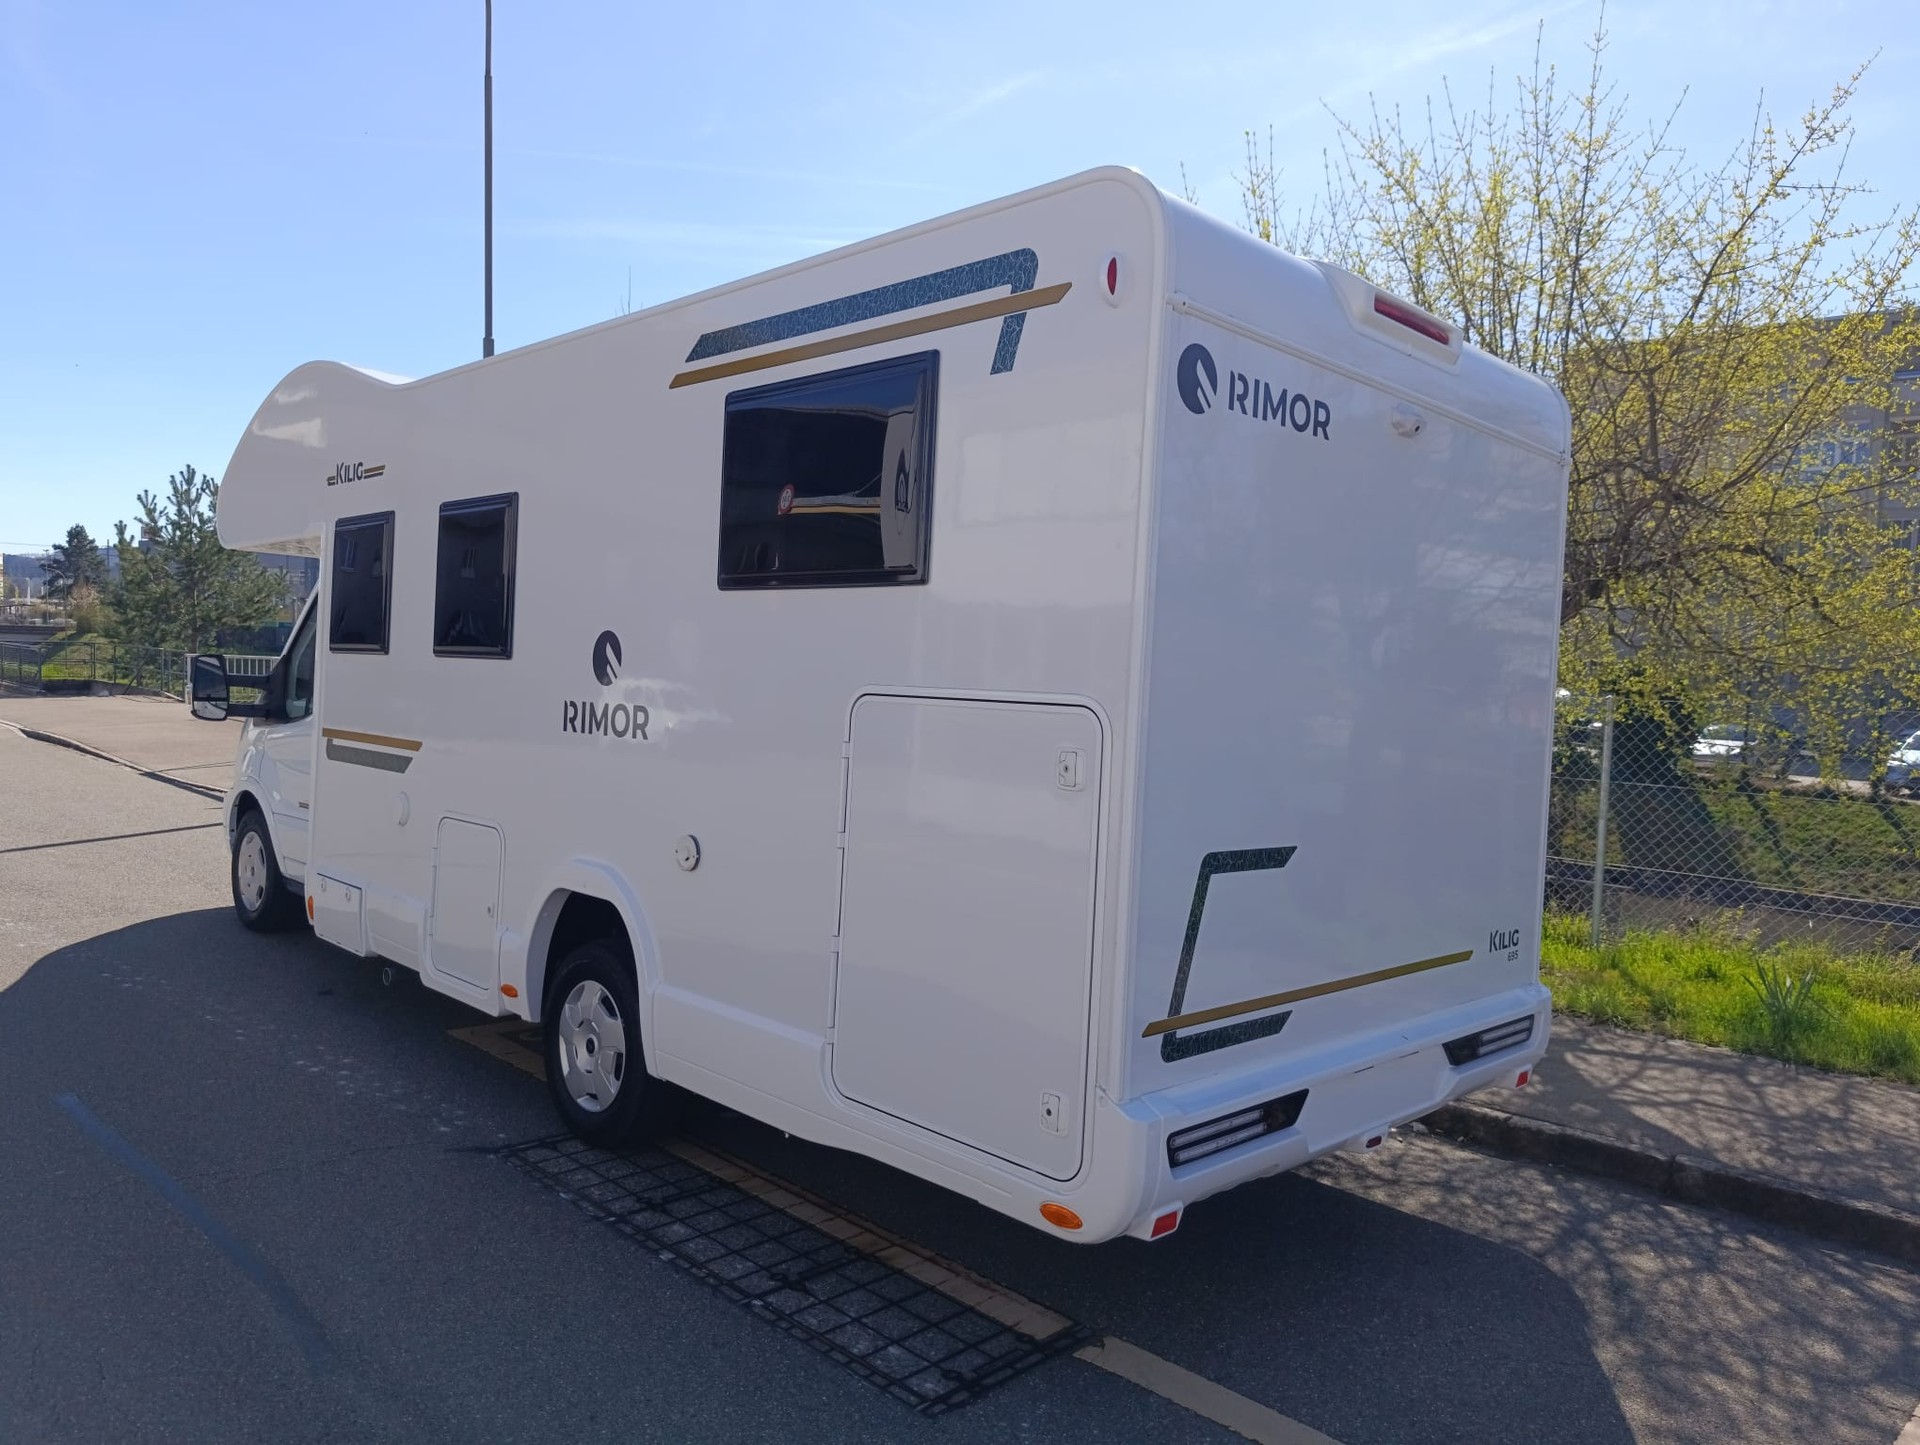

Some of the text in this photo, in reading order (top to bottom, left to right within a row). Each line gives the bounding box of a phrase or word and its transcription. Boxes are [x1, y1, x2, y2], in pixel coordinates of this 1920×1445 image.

[1228, 370, 1331, 441] RIMOR
[336, 461, 364, 485] KILIG
[563, 700, 650, 740] RIMOR
[1489, 929, 1519, 953] KILIG
